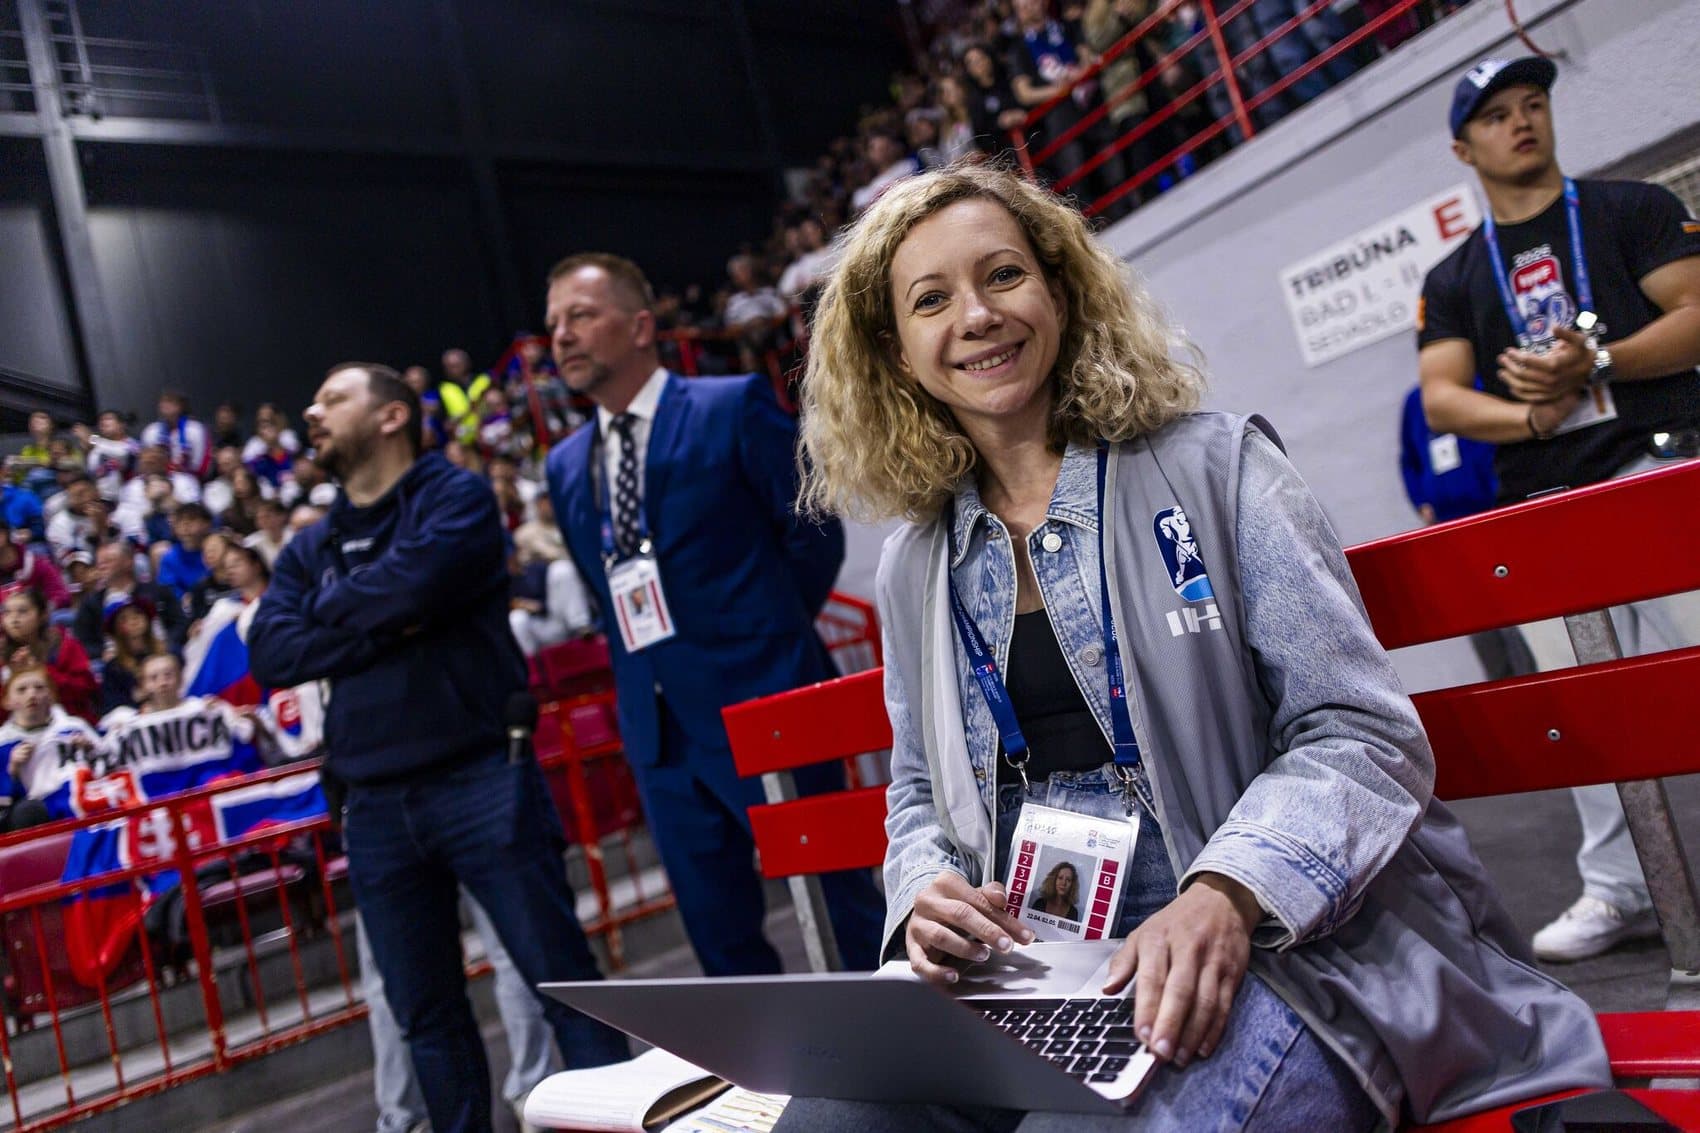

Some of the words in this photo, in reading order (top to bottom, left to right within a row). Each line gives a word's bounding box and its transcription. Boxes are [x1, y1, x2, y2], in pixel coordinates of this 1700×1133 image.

[1432, 198, 1473, 243] E
[1026, 841, 1031, 852] 1
[1022, 855, 1029, 865] 2
[1018, 868, 1026, 878] 3
[1015, 882, 1022, 891] 4
[1012, 895, 1018, 904] 5
[1008, 907, 1016, 917] 6
